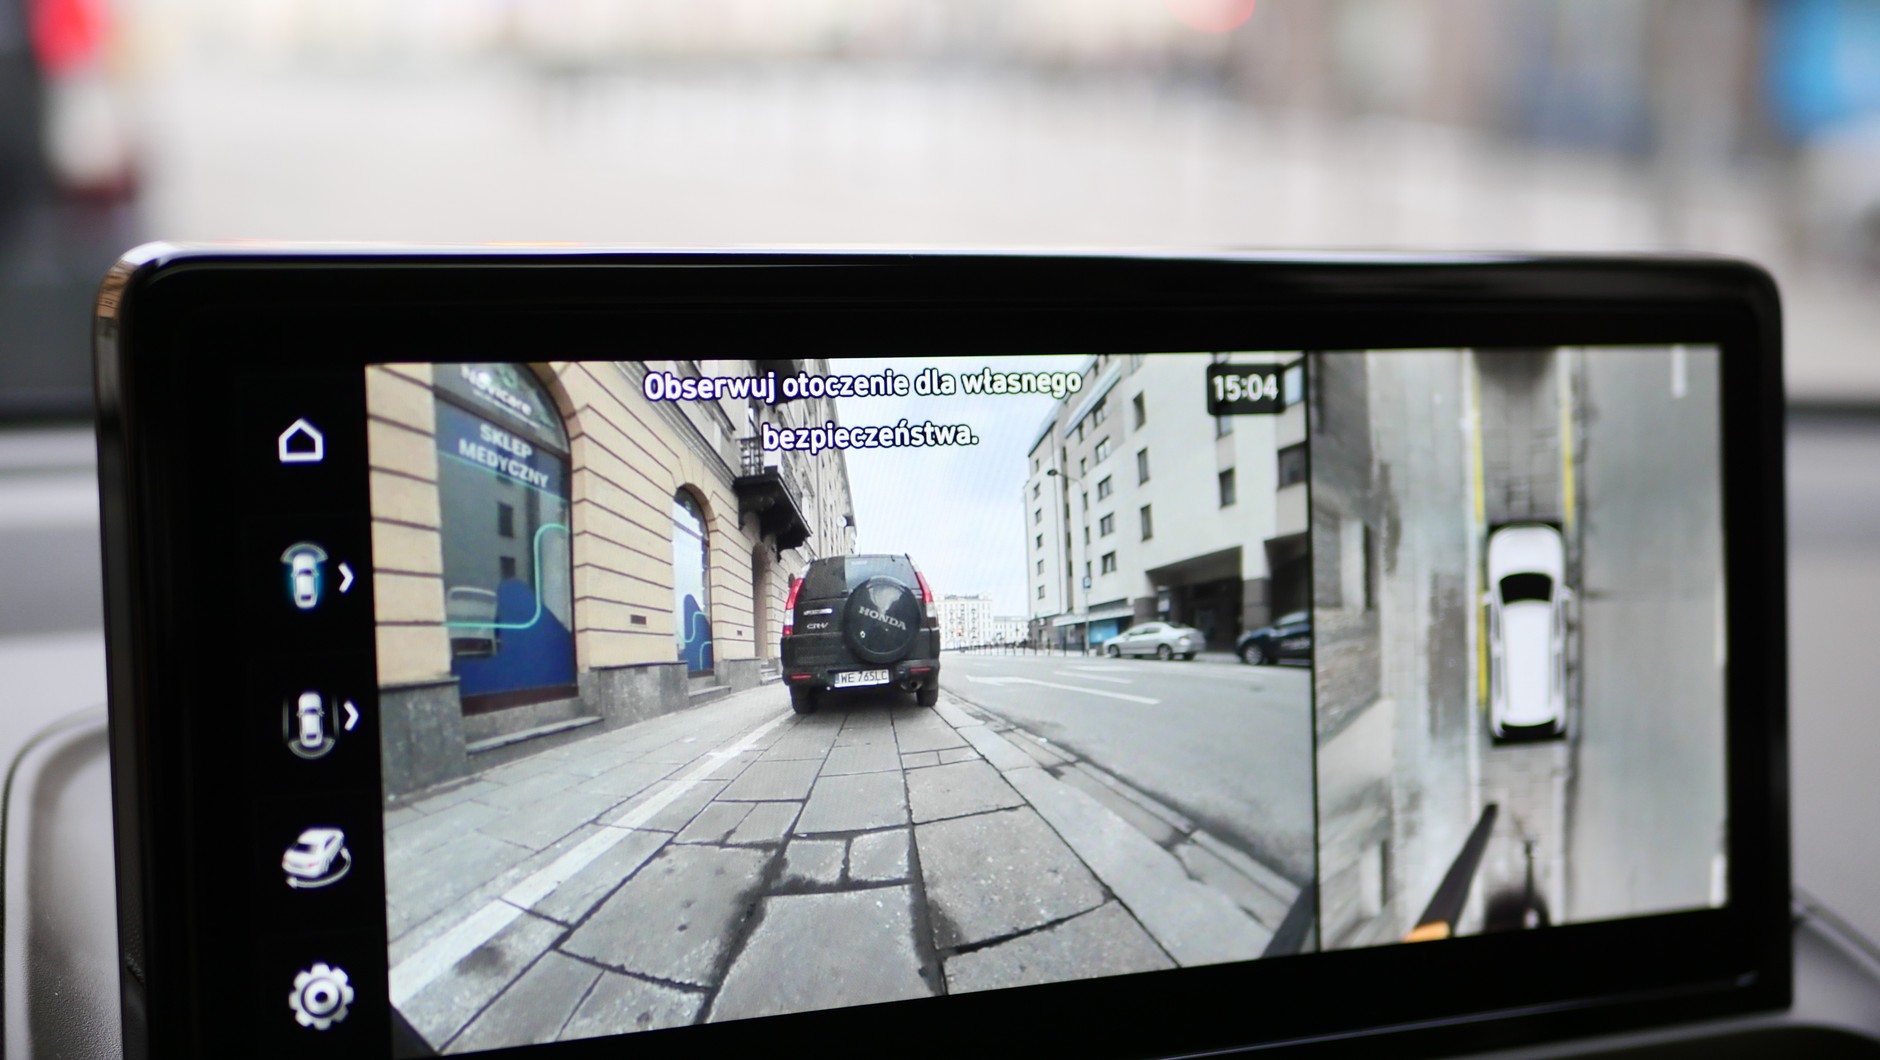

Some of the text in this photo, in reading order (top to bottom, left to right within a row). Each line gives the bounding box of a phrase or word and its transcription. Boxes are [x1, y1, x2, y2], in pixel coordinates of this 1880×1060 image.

[644, 367, 1082, 404] Obserwuj otoczenie dla własnego
[1212, 373, 1279, 402] 15:04
[480, 423, 533, 459] SKLEP
[762, 418, 979, 456] bezpieczeństwa.
[459, 438, 549, 488] MEDYCZNY
[858, 606, 906, 630] HONDA
[841, 673, 855, 684] WE
